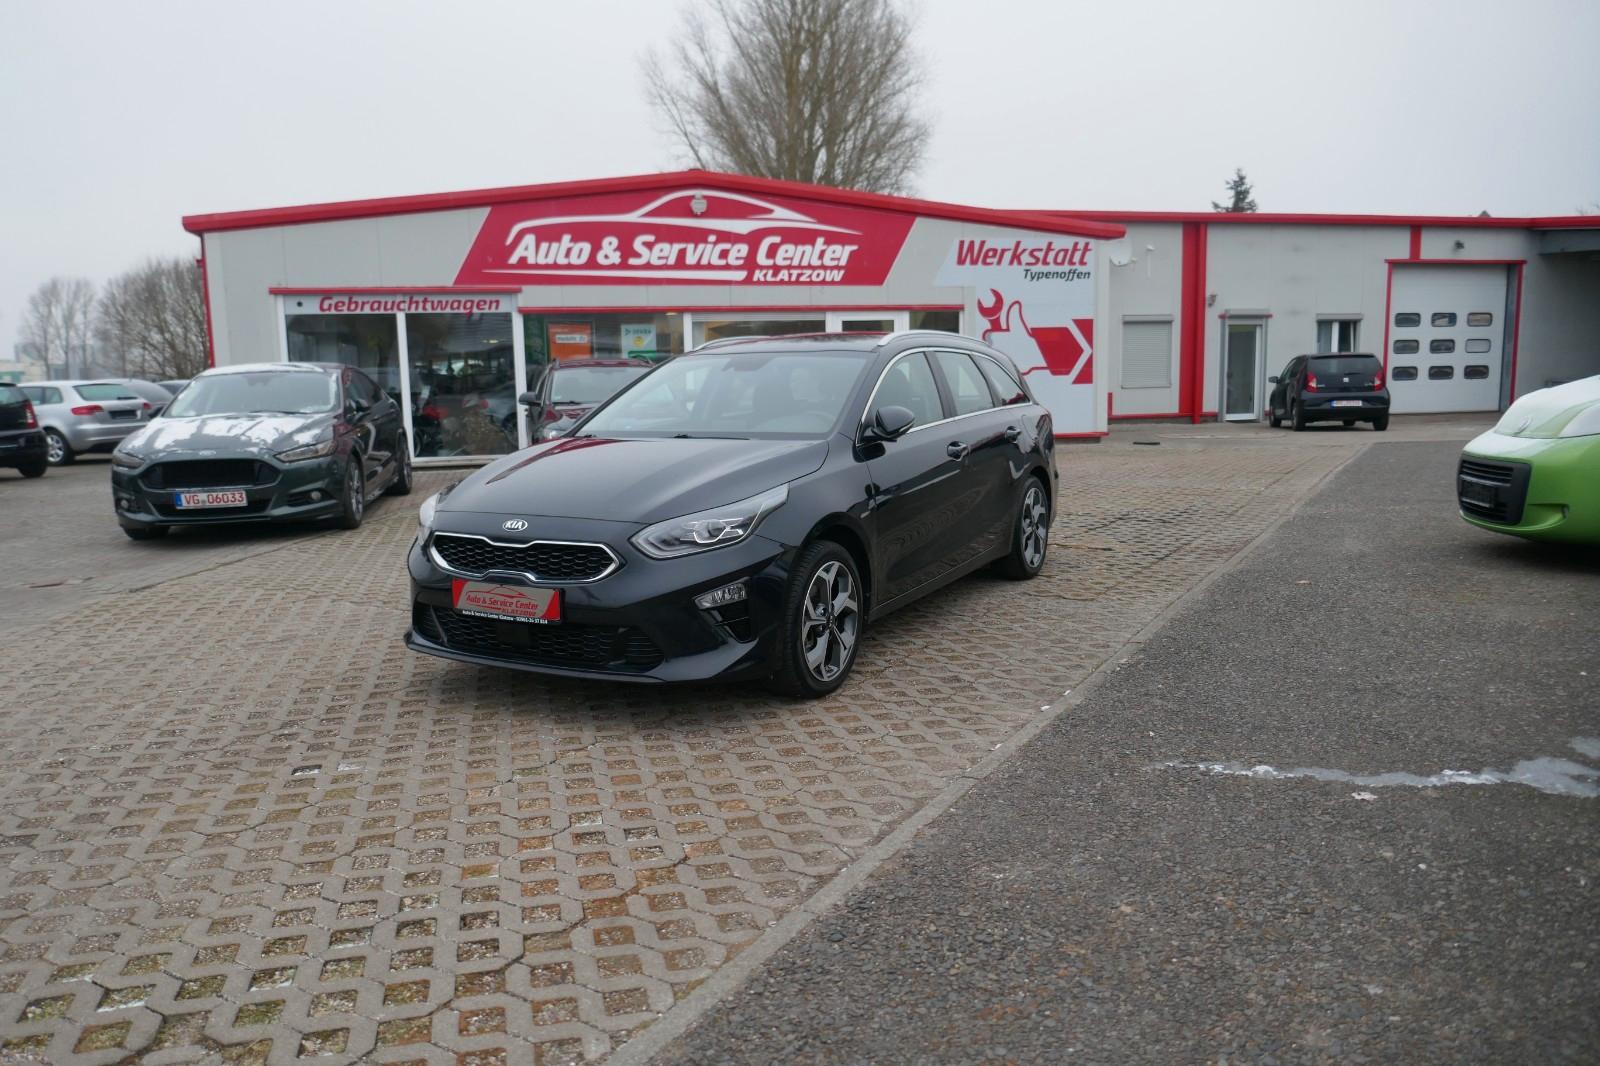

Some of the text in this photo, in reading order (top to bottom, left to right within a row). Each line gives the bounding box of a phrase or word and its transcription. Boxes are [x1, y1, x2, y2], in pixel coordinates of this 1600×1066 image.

[508, 234, 858, 267] Auto & Service Center
[956, 240, 1092, 266] Werkstatt
[753, 269, 844, 282] KLATZOW
[1023, 268, 1091, 282] Typenoffen
[319, 296, 500, 320] Gebrauchtwagen
[184, 492, 244, 505] VG 06033
[505, 520, 523, 529] KIA
[467, 595, 481, 604] Auto
[488, 598, 513, 607] Service
[515, 601, 538, 610] Center
